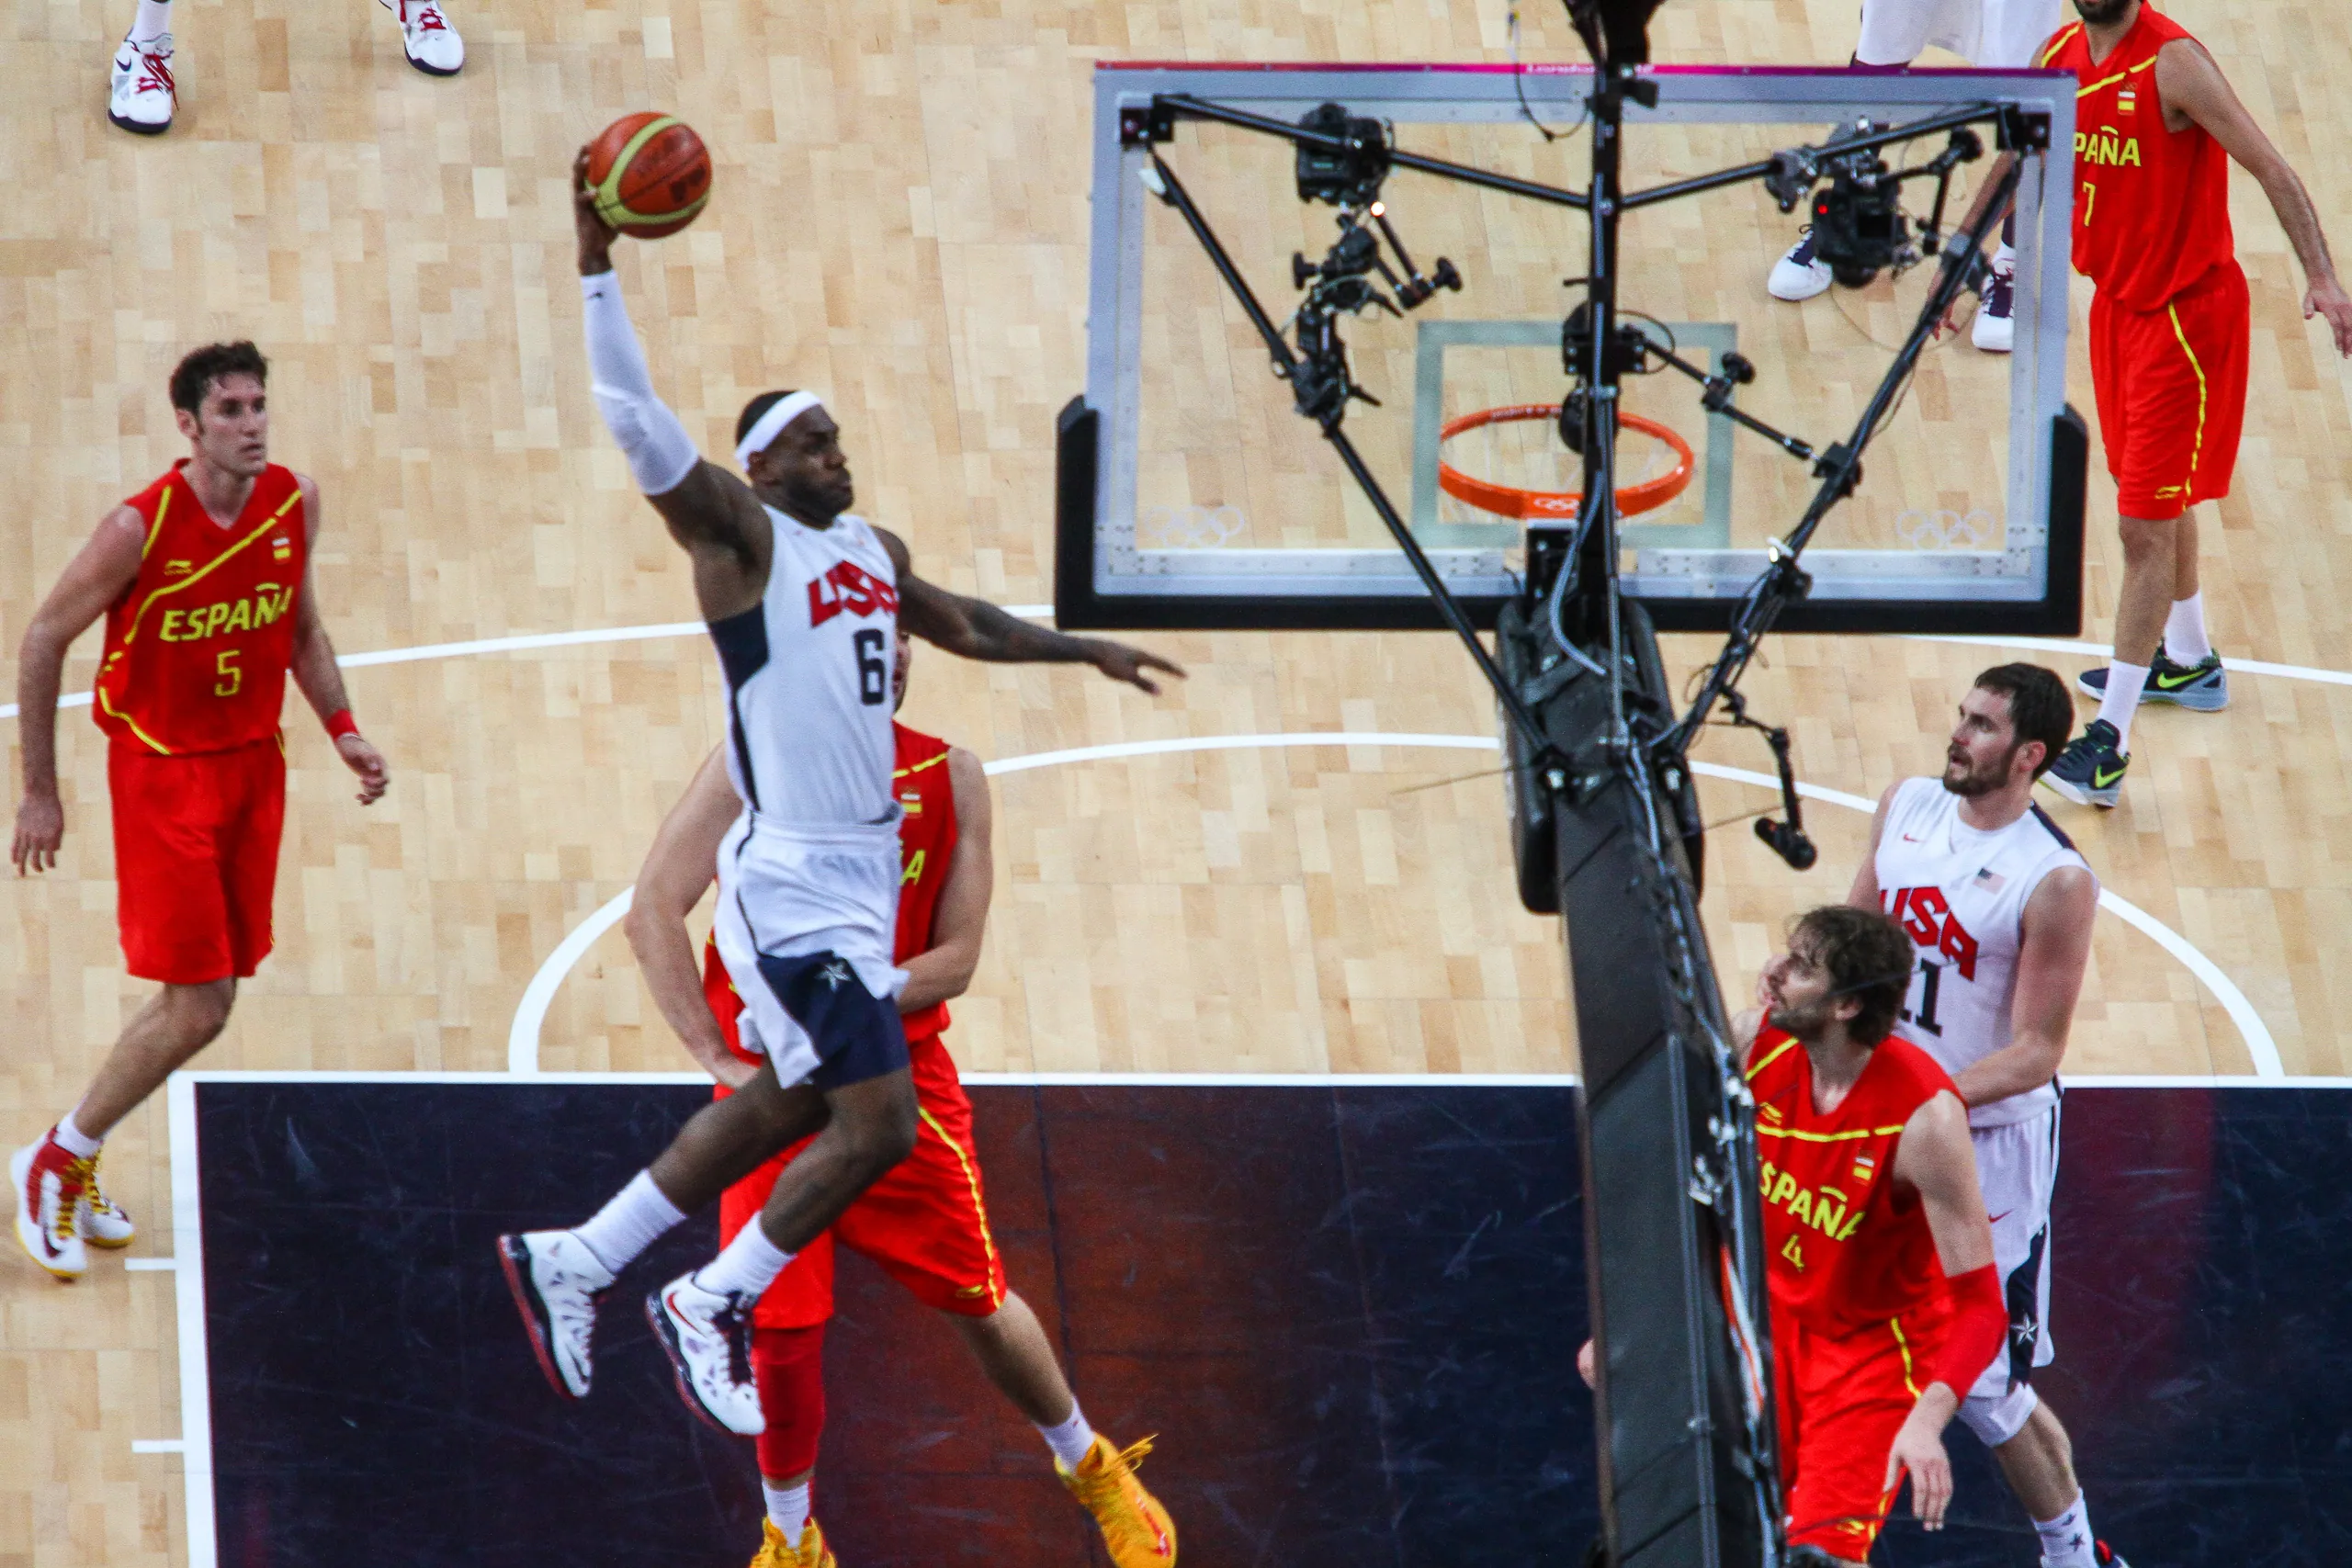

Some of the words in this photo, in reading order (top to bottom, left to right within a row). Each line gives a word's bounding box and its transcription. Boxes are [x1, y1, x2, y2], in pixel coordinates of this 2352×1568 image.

[2073, 125, 2142, 167] PAÑA
[2082, 181, 2097, 227] 7
[808, 559, 899, 629] USA
[213, 649, 241, 697] 5
[853, 628, 885, 705] 6
[1879, 886, 1979, 983] USA
[1898, 957, 1943, 1038] 1
[1757, 1155, 1866, 1242] SPAÑA
[1781, 1234, 1805, 1273] 4
